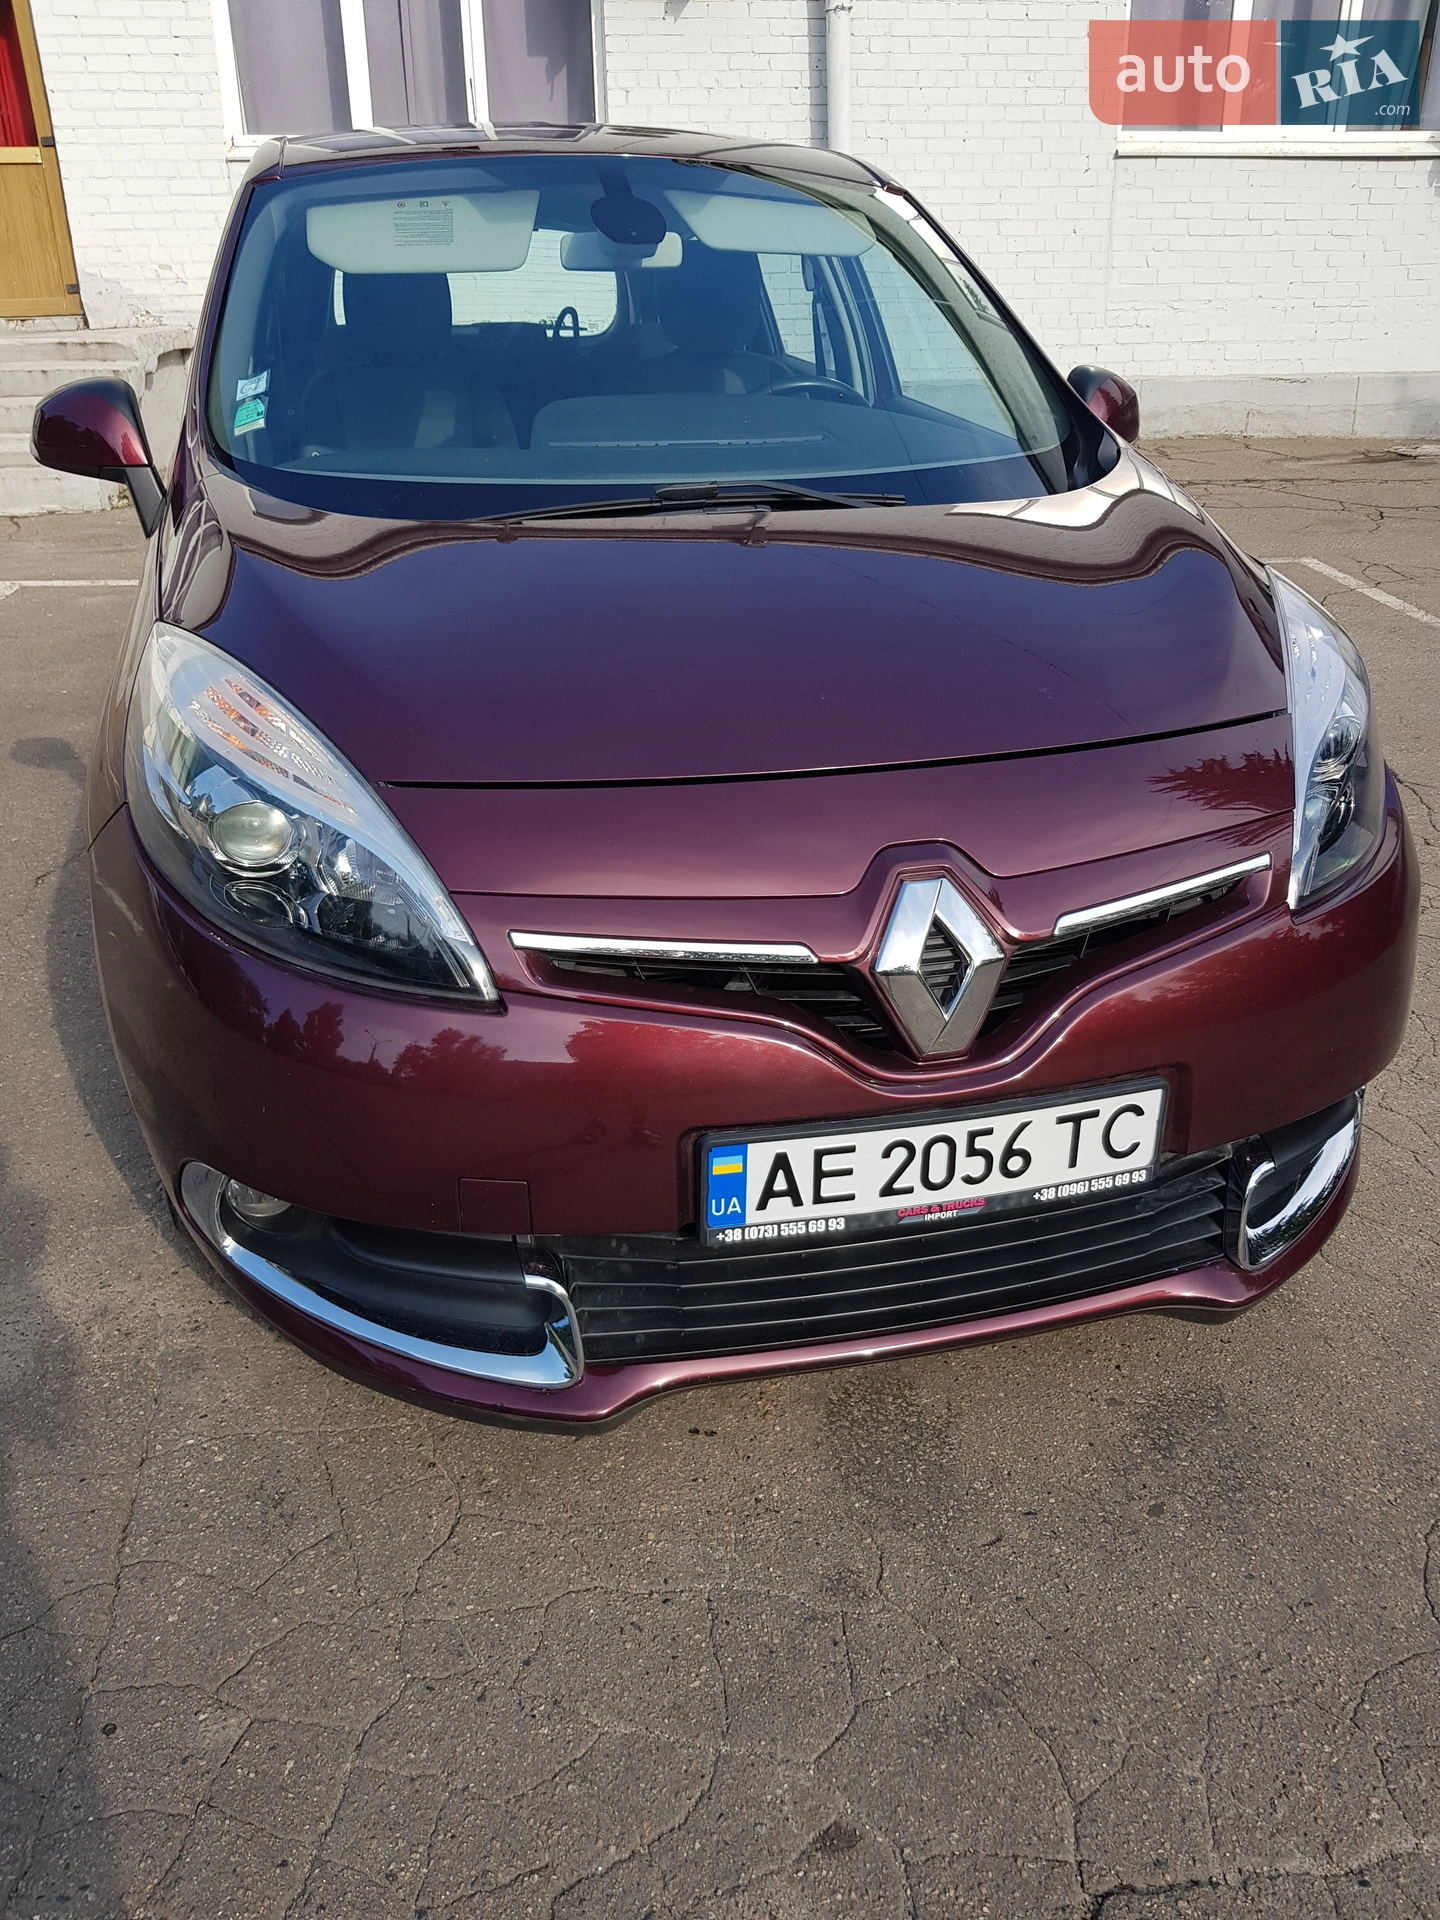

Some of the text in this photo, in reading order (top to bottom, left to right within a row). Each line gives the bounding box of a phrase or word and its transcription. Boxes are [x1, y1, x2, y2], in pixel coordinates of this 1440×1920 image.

[755, 1102, 1145, 1211] AE 2056 TC
[1032, 1169, 1147, 1201] +38 (096) 555 69 93
[711, 1196, 742, 1216] UA
[897, 1197, 987, 1219] CARS & TRUCKS
[924, 1209, 959, 1222] IMPORT
[716, 1217, 845, 1242] +38 (073) 555 69 93
